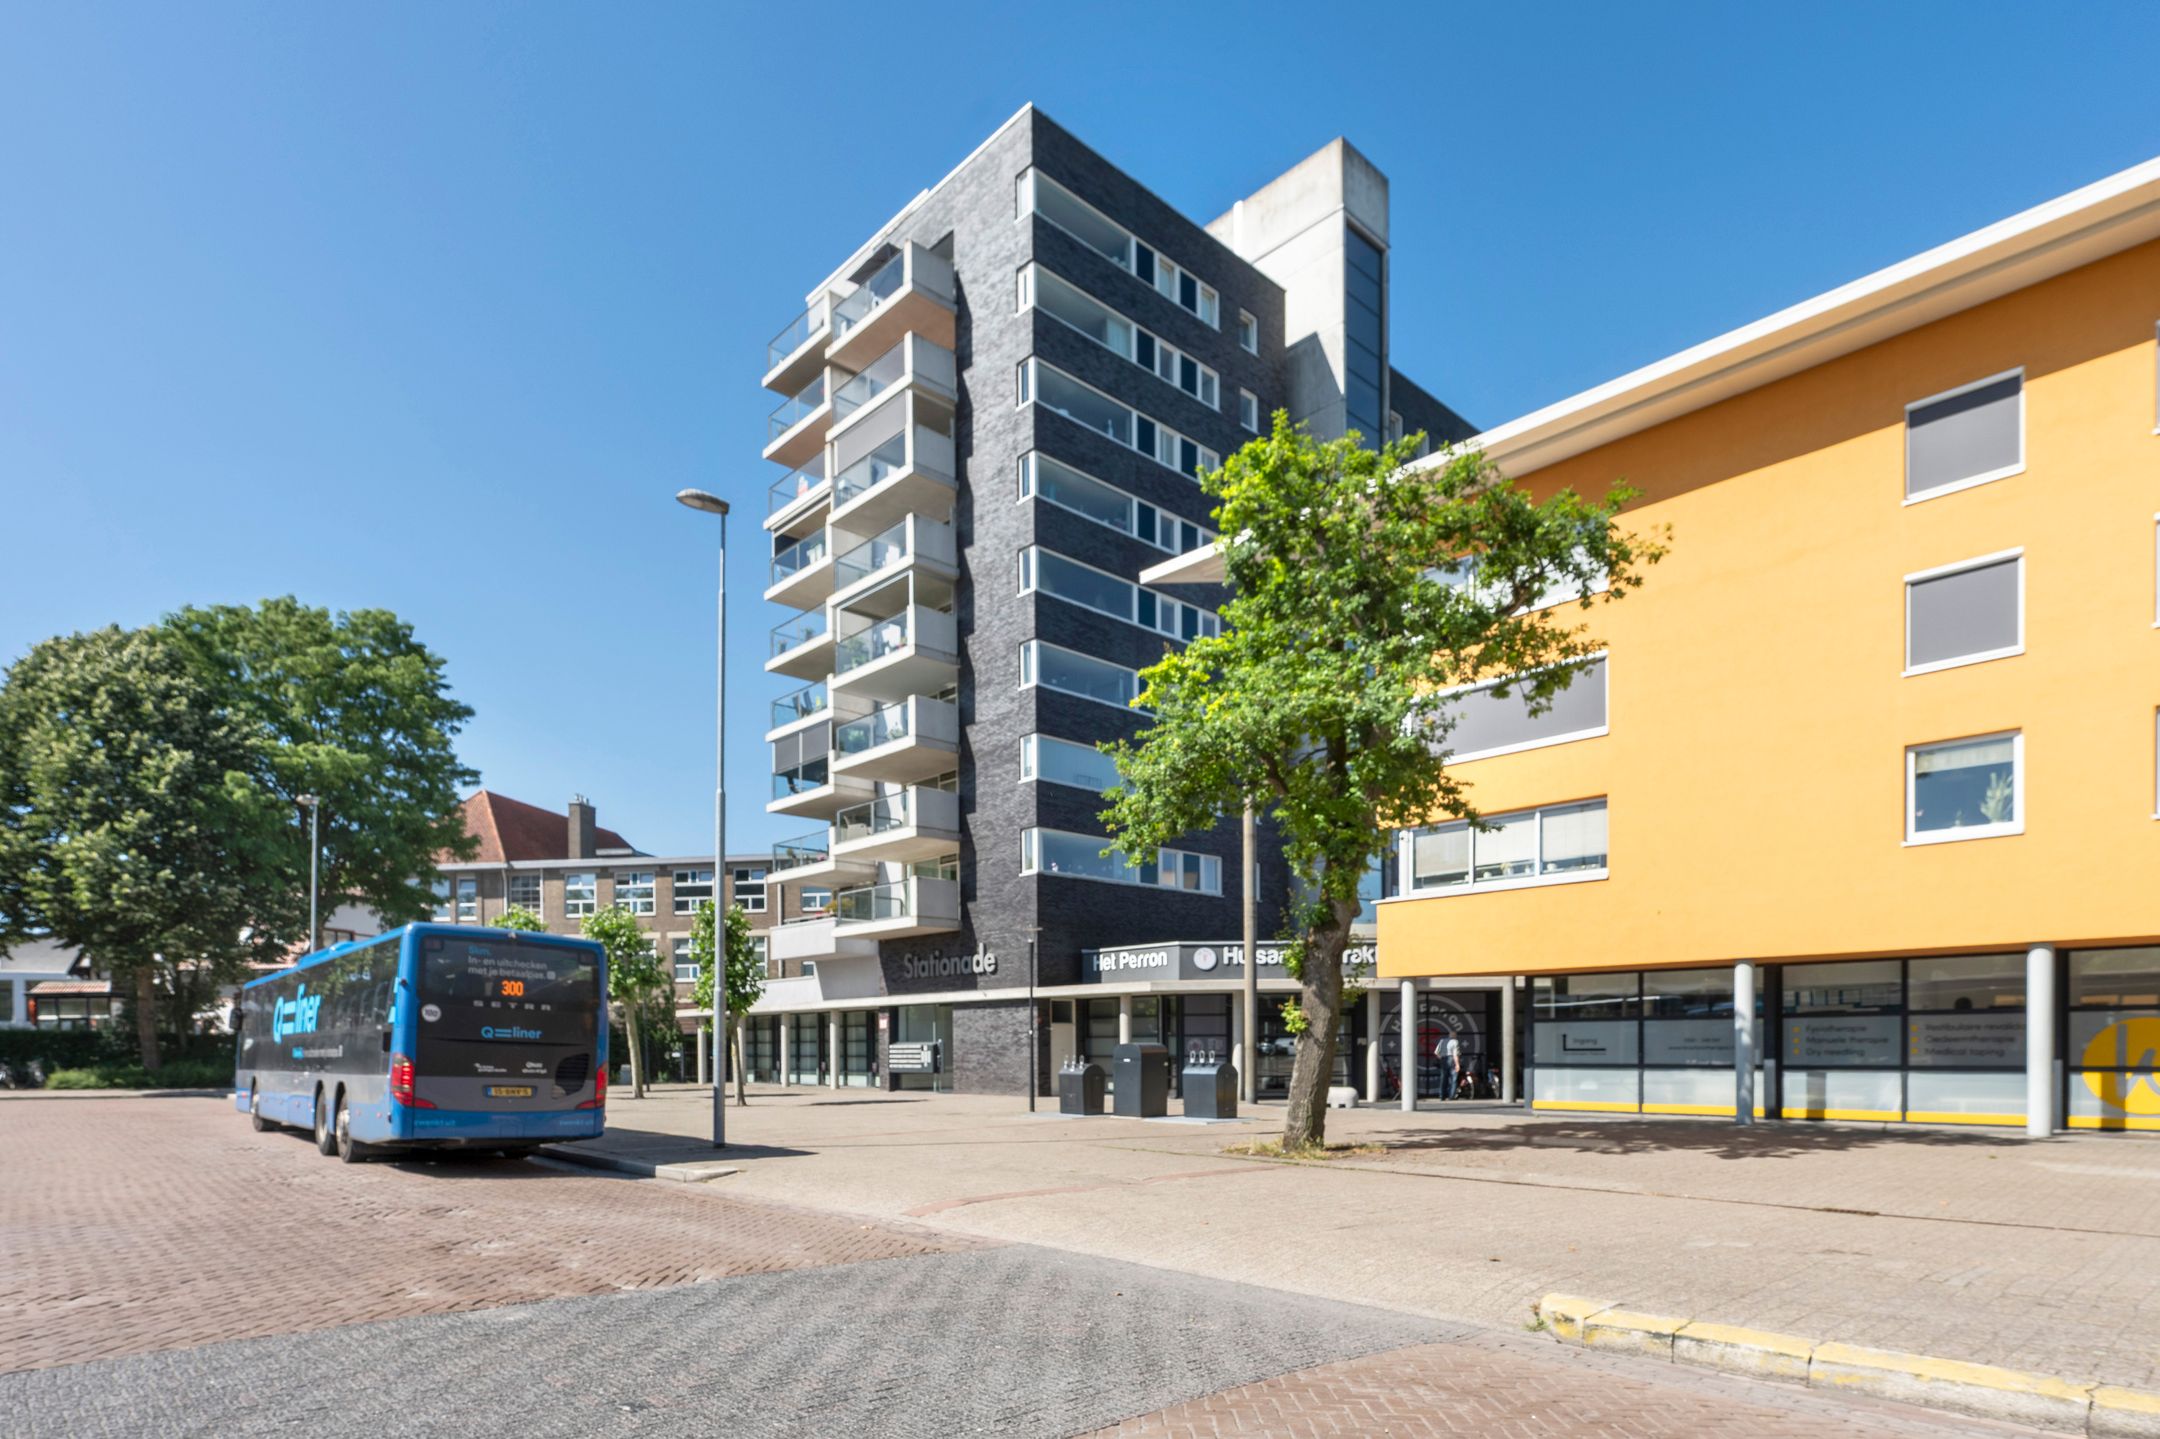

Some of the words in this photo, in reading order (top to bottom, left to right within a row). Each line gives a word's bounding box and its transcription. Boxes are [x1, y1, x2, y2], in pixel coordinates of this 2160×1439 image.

[903, 942, 998, 979] Stationade
[1093, 953, 1117, 972] Het
[1119, 951, 1168, 970] Perron
[500, 979, 524, 996] 300
